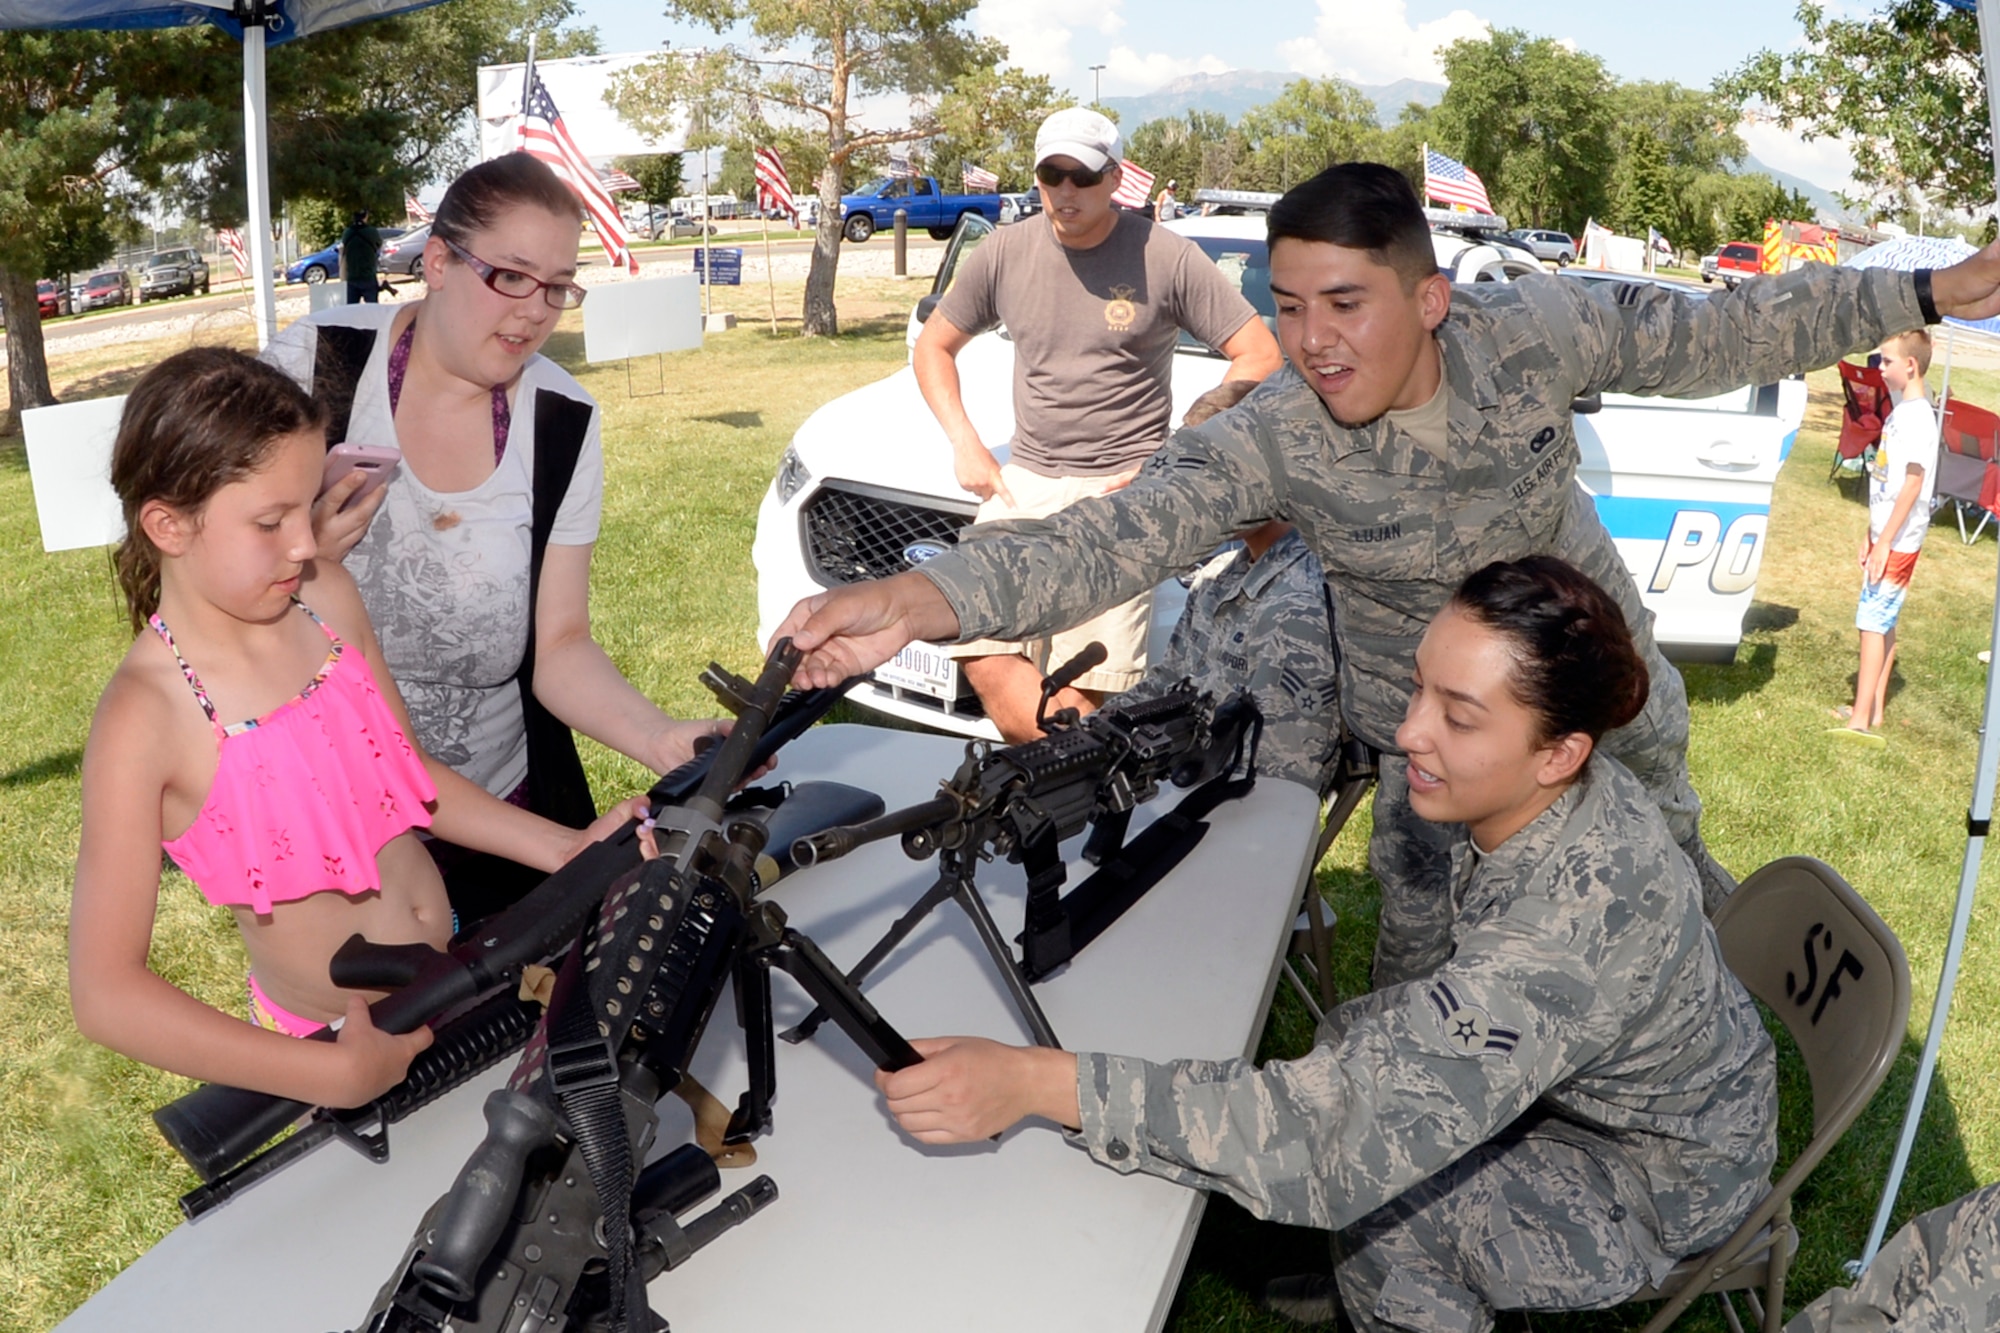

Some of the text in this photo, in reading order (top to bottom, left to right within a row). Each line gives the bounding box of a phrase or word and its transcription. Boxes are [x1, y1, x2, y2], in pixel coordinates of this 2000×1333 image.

[1512, 476, 1537, 499] U.S.
[1536, 458, 1554, 481] AIR
[1354, 521, 1401, 543] LUJAN
[1647, 509, 1769, 596] PO
[1786, 922, 1864, 1026] SF
